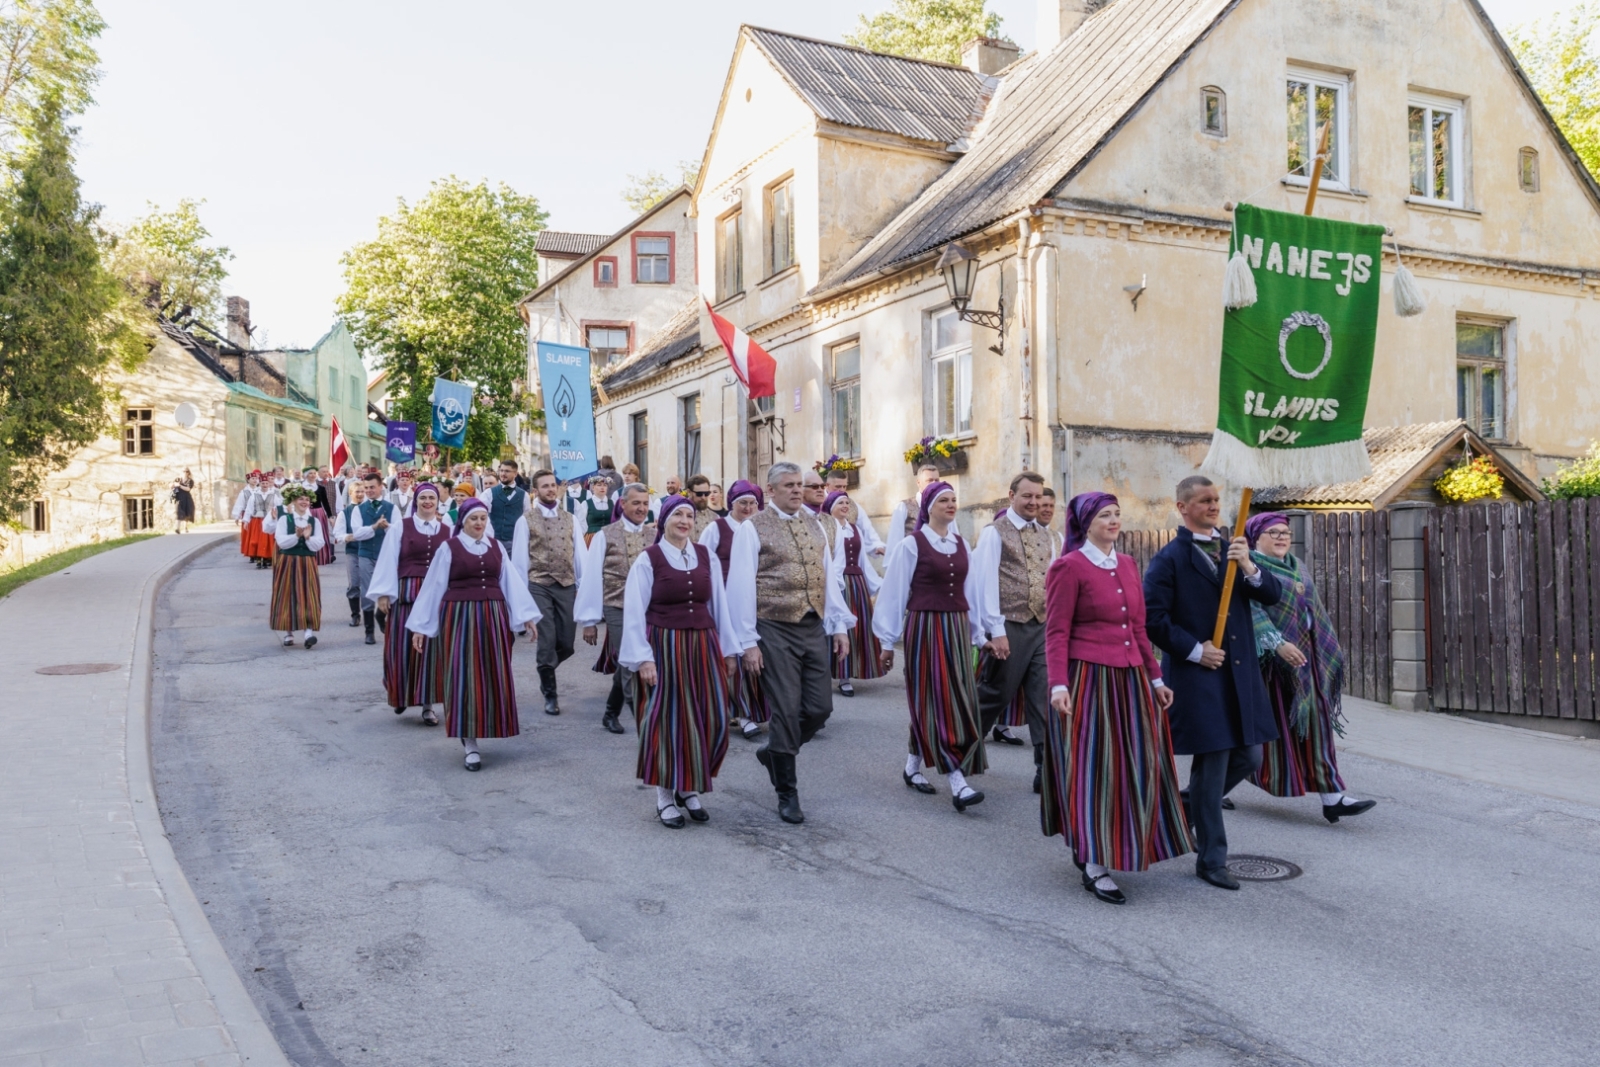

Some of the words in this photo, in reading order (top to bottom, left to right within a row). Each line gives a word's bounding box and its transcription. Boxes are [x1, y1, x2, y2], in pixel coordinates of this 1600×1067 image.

[1242, 234, 1373, 297] NAMEJS
[546, 352, 582, 367] SLAMPE
[1244, 390, 1340, 422] SLAMPES
[551, 450, 585, 461] AISMA
